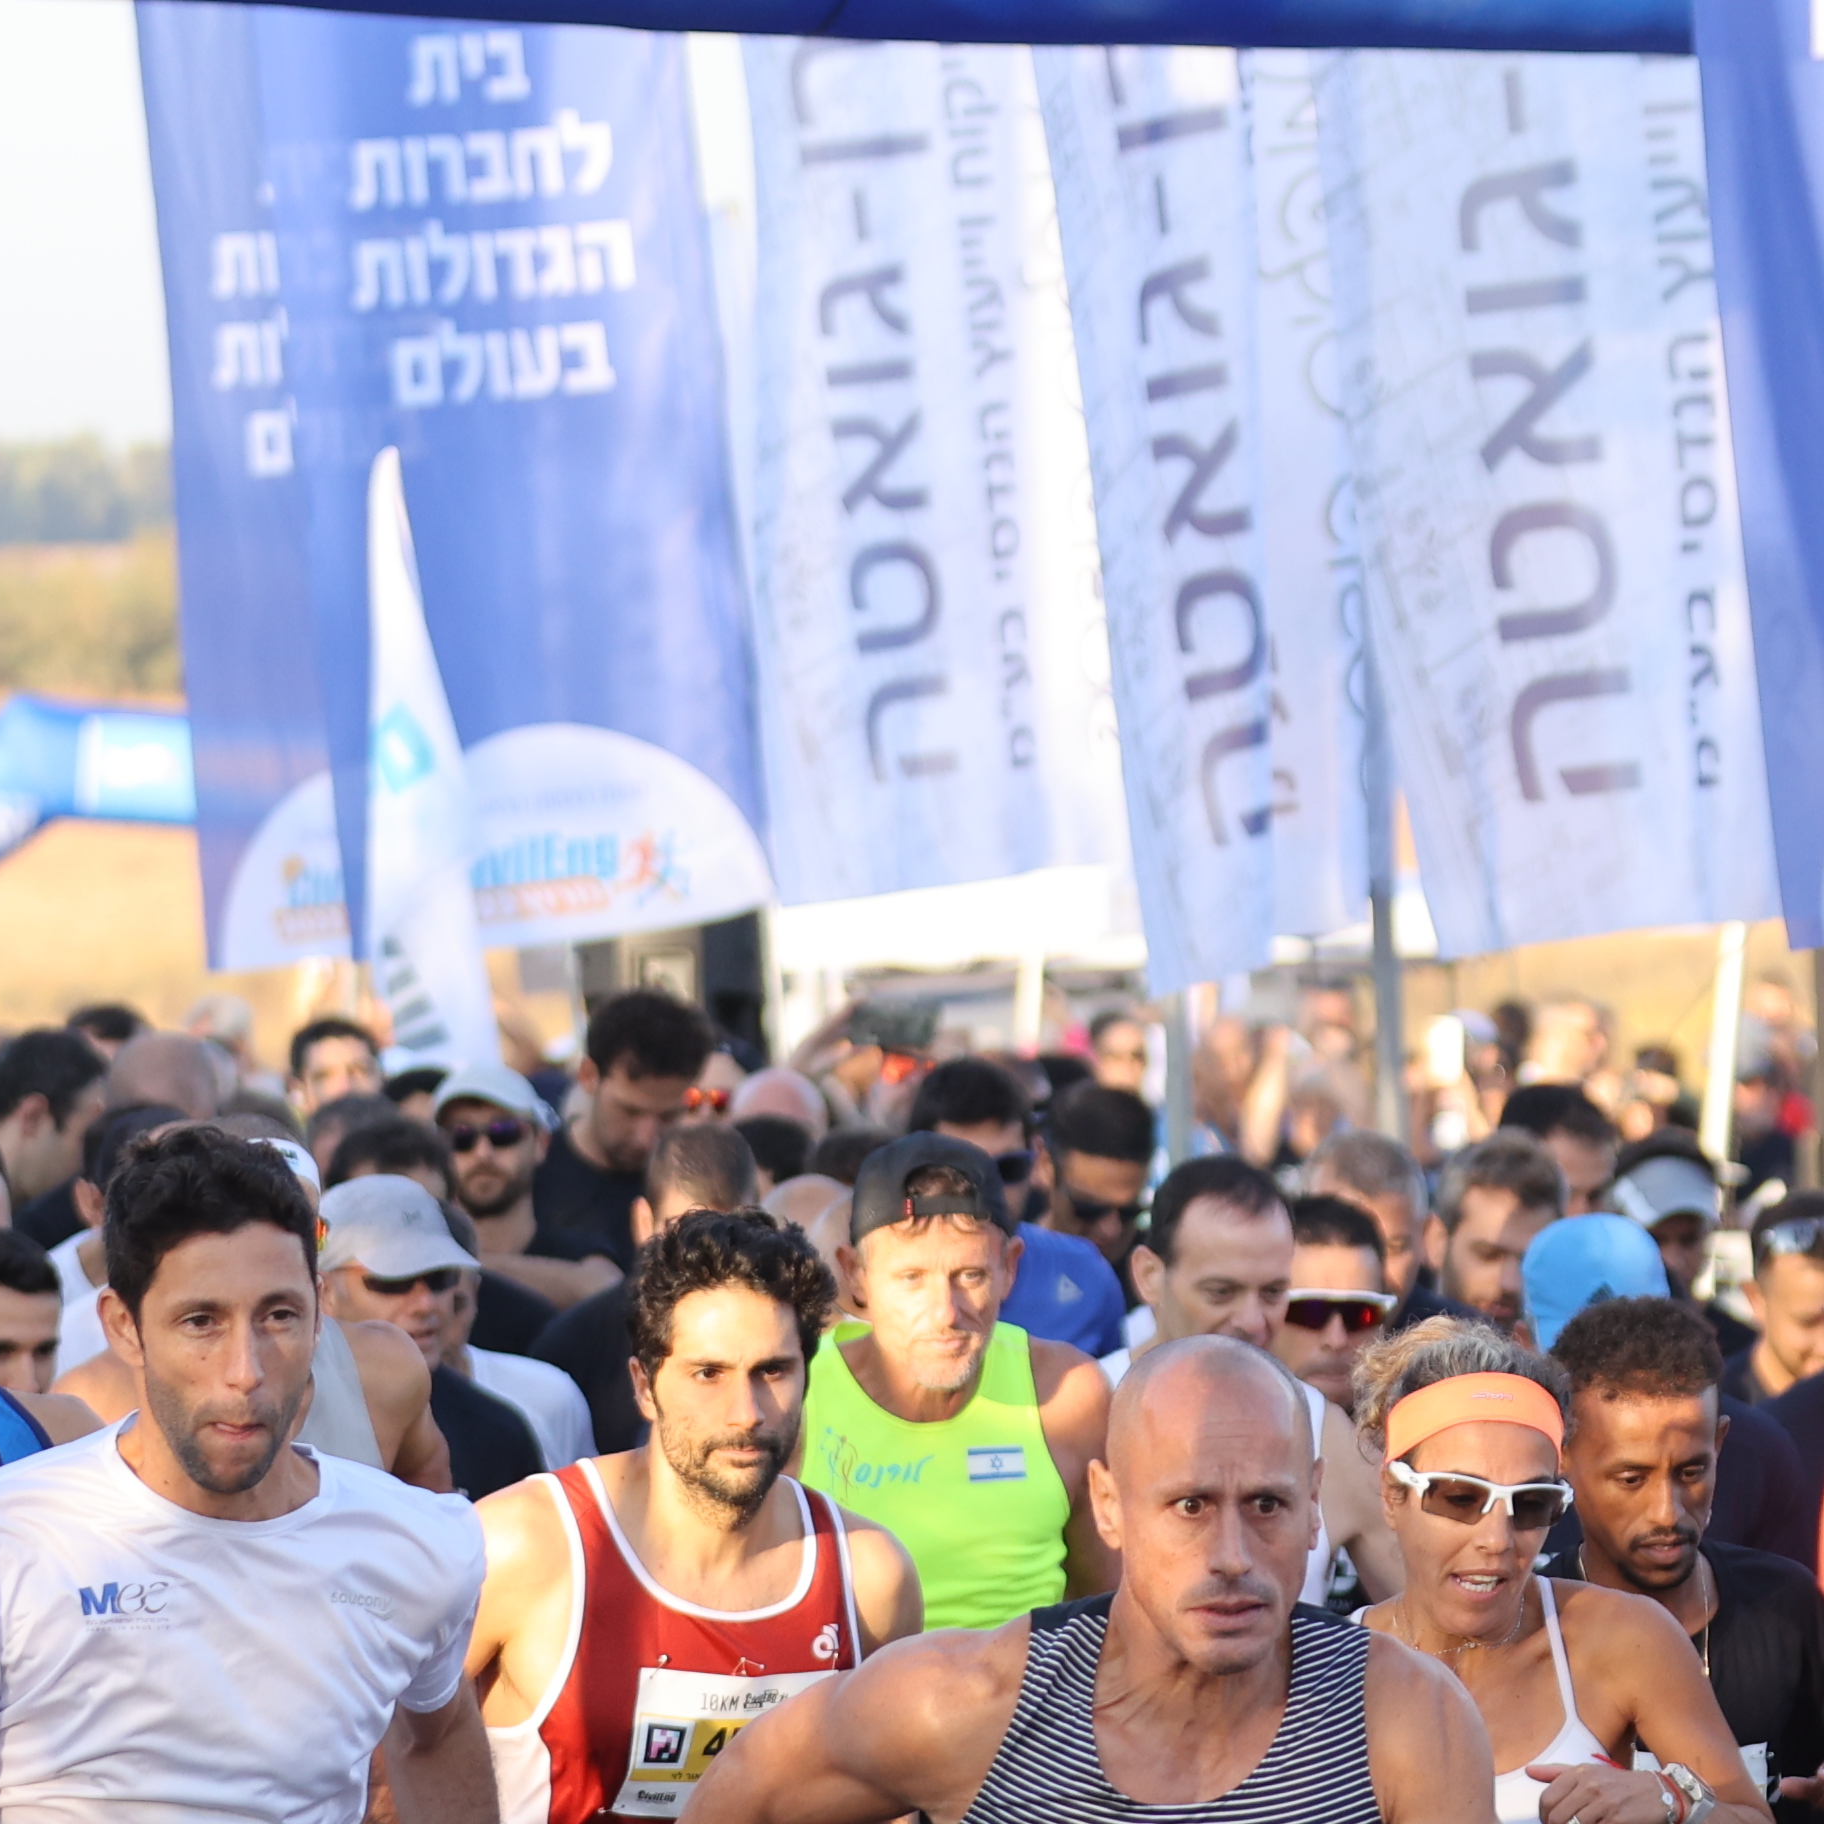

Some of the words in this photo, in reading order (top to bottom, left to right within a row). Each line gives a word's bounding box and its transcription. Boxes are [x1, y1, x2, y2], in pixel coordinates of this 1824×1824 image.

[408, 30, 530, 106] בית
[351, 108, 614, 211] לחברות
[353, 218, 637, 312] הגדולות
[392, 321, 616, 408] בעולם
[330, 1589, 393, 1610] saucony
[700, 1693, 739, 1711] 10KM
